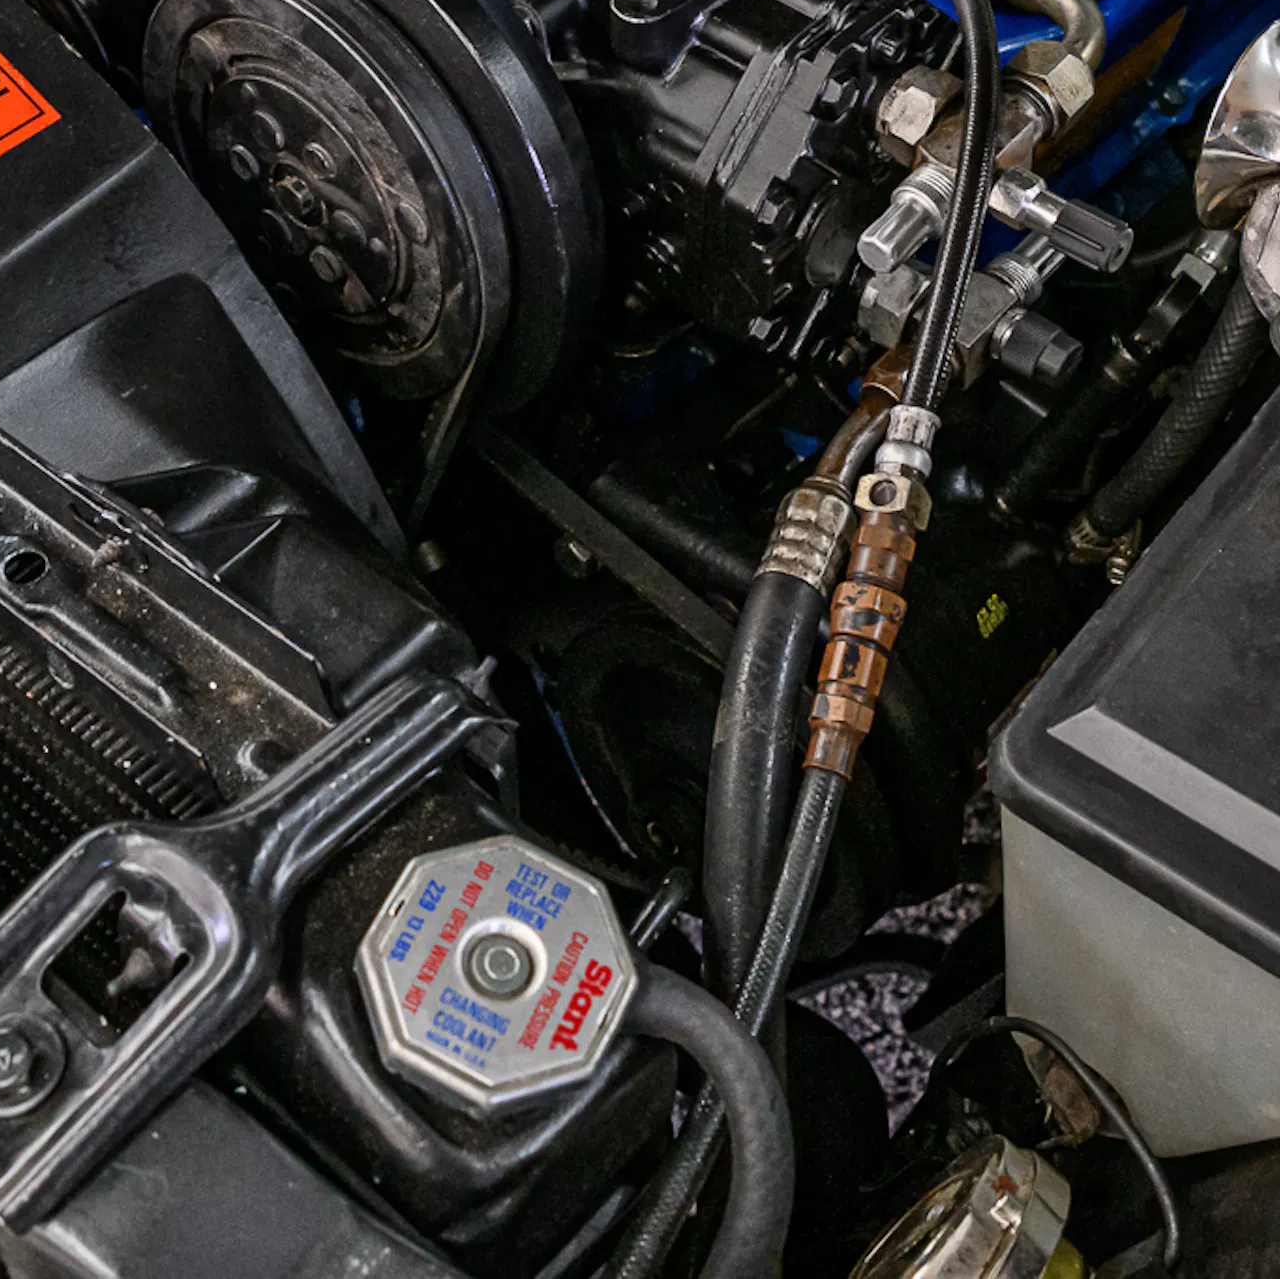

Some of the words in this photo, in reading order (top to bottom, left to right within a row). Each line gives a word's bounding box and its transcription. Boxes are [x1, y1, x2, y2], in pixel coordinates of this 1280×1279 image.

[474, 861, 494, 881] DO
[517, 864, 548, 888] TEST
[552, 882, 571, 900] OR
[418, 880, 446, 912] 229
[460, 881, 483, 909] NOT
[506, 879, 562, 918] REPLACE
[440, 908, 468, 943] OPEN
[506, 900, 547, 930] WHEN
[417, 945, 448, 985] WHEN
[551, 931, 588, 985] CAUTION
[403, 985, 426, 1014] HOT
[441, 987, 509, 1034] CHANGING
[548, 959, 613, 1051] Stant
[433, 1011, 496, 1050] COOLANT
[518, 986, 561, 1051] PRESSURE
